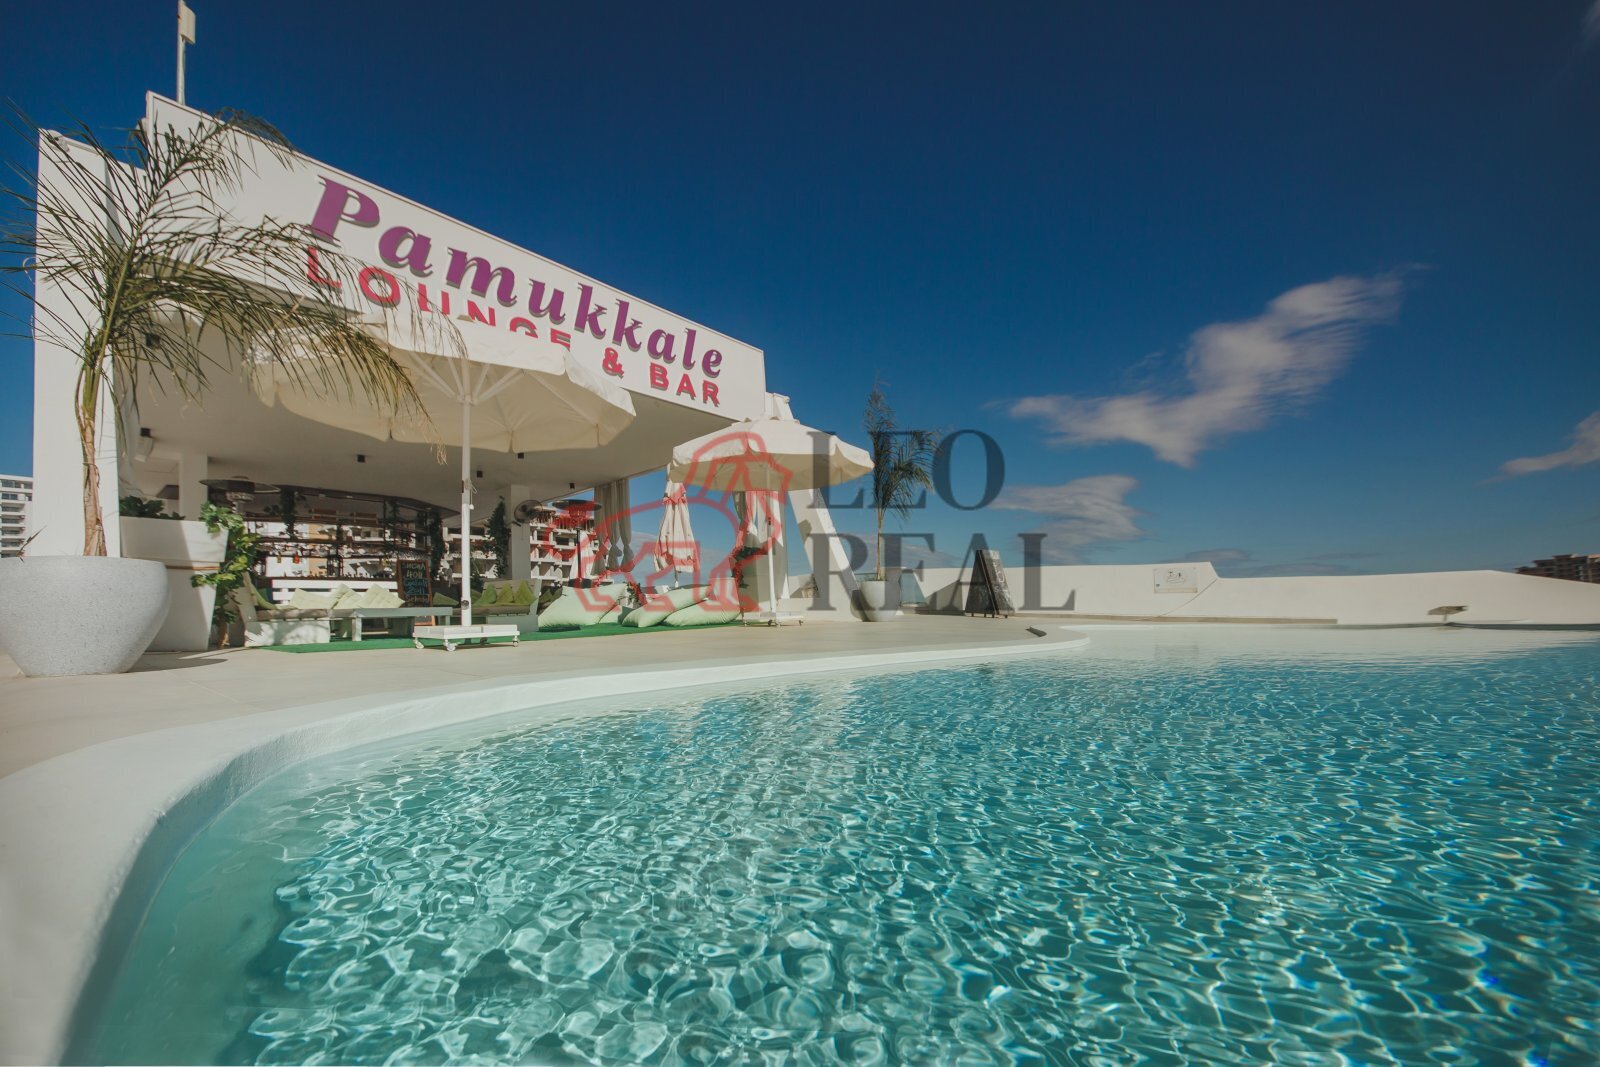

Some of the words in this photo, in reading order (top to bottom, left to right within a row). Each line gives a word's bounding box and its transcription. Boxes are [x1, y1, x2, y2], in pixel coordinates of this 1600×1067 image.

[309, 174, 723, 377] Pamukkale
[602, 347, 625, 377] &
[649, 362, 720, 406] BAR
